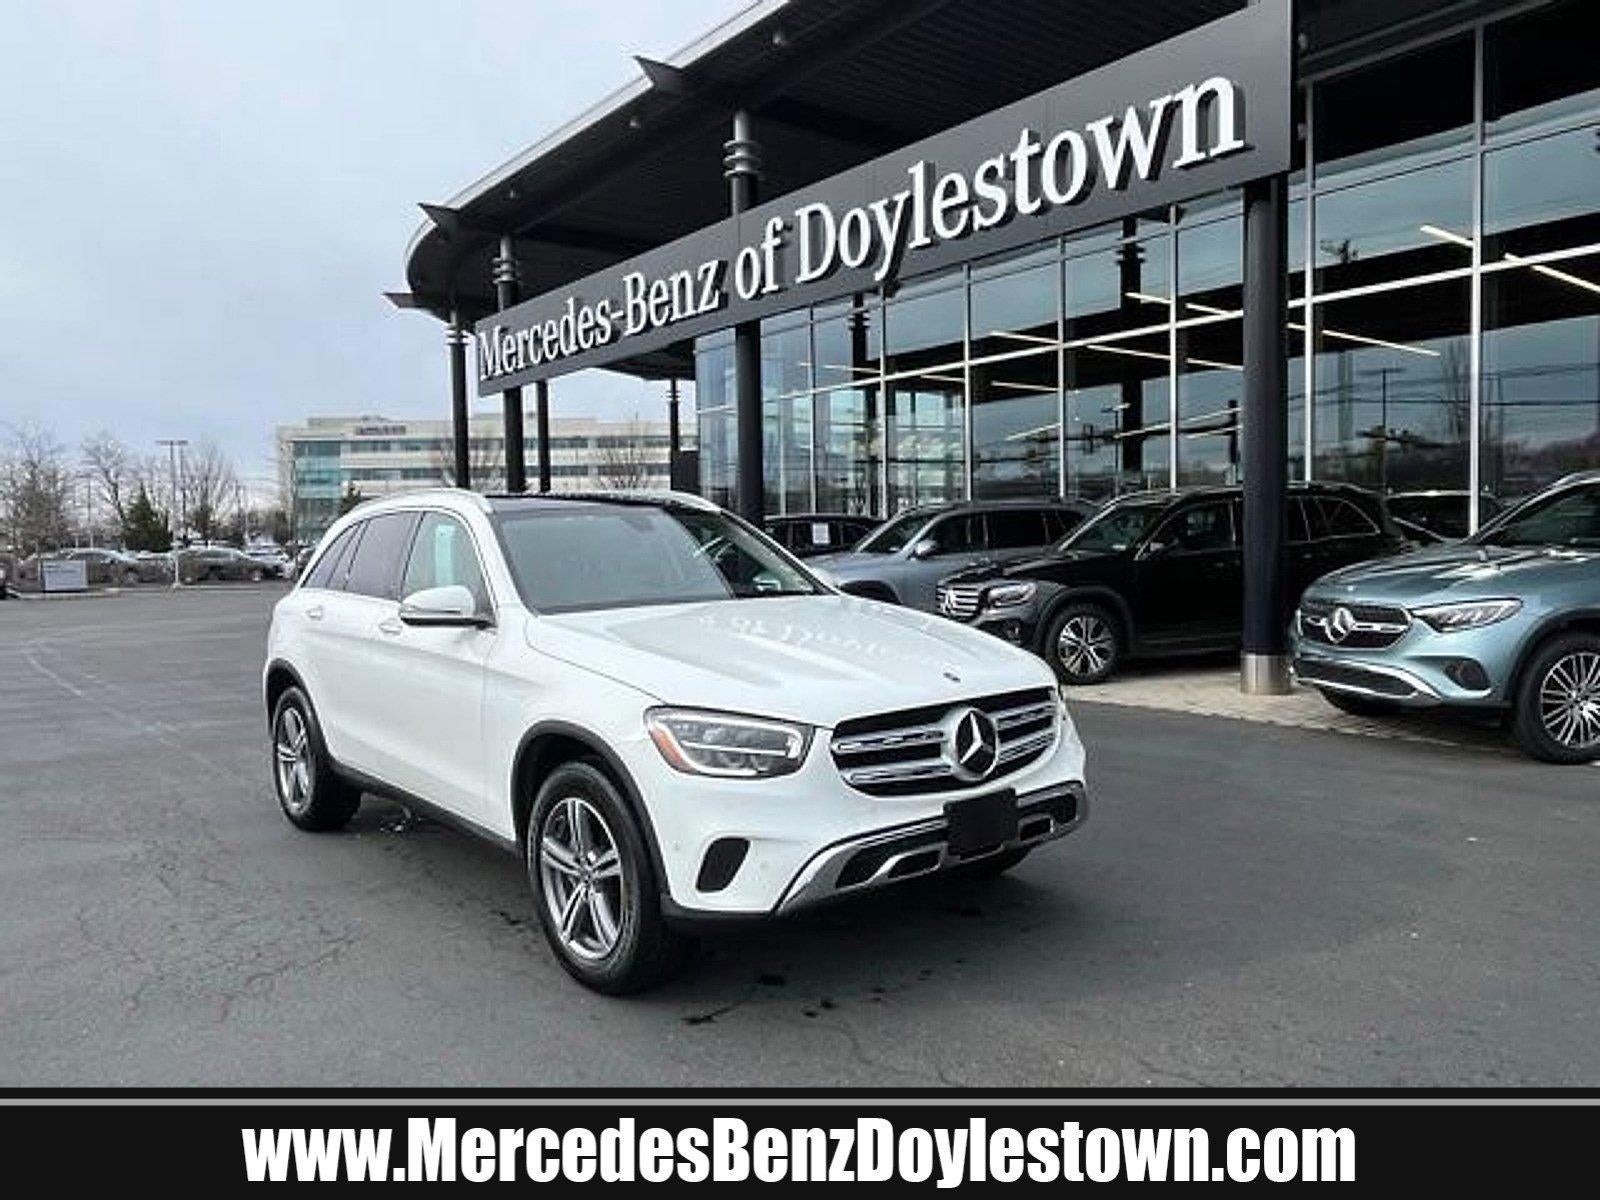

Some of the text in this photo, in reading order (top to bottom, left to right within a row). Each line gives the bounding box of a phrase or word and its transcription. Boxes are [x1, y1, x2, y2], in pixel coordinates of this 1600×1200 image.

[478, 75, 1245, 381] Mercedes-Benz of Doylestown
